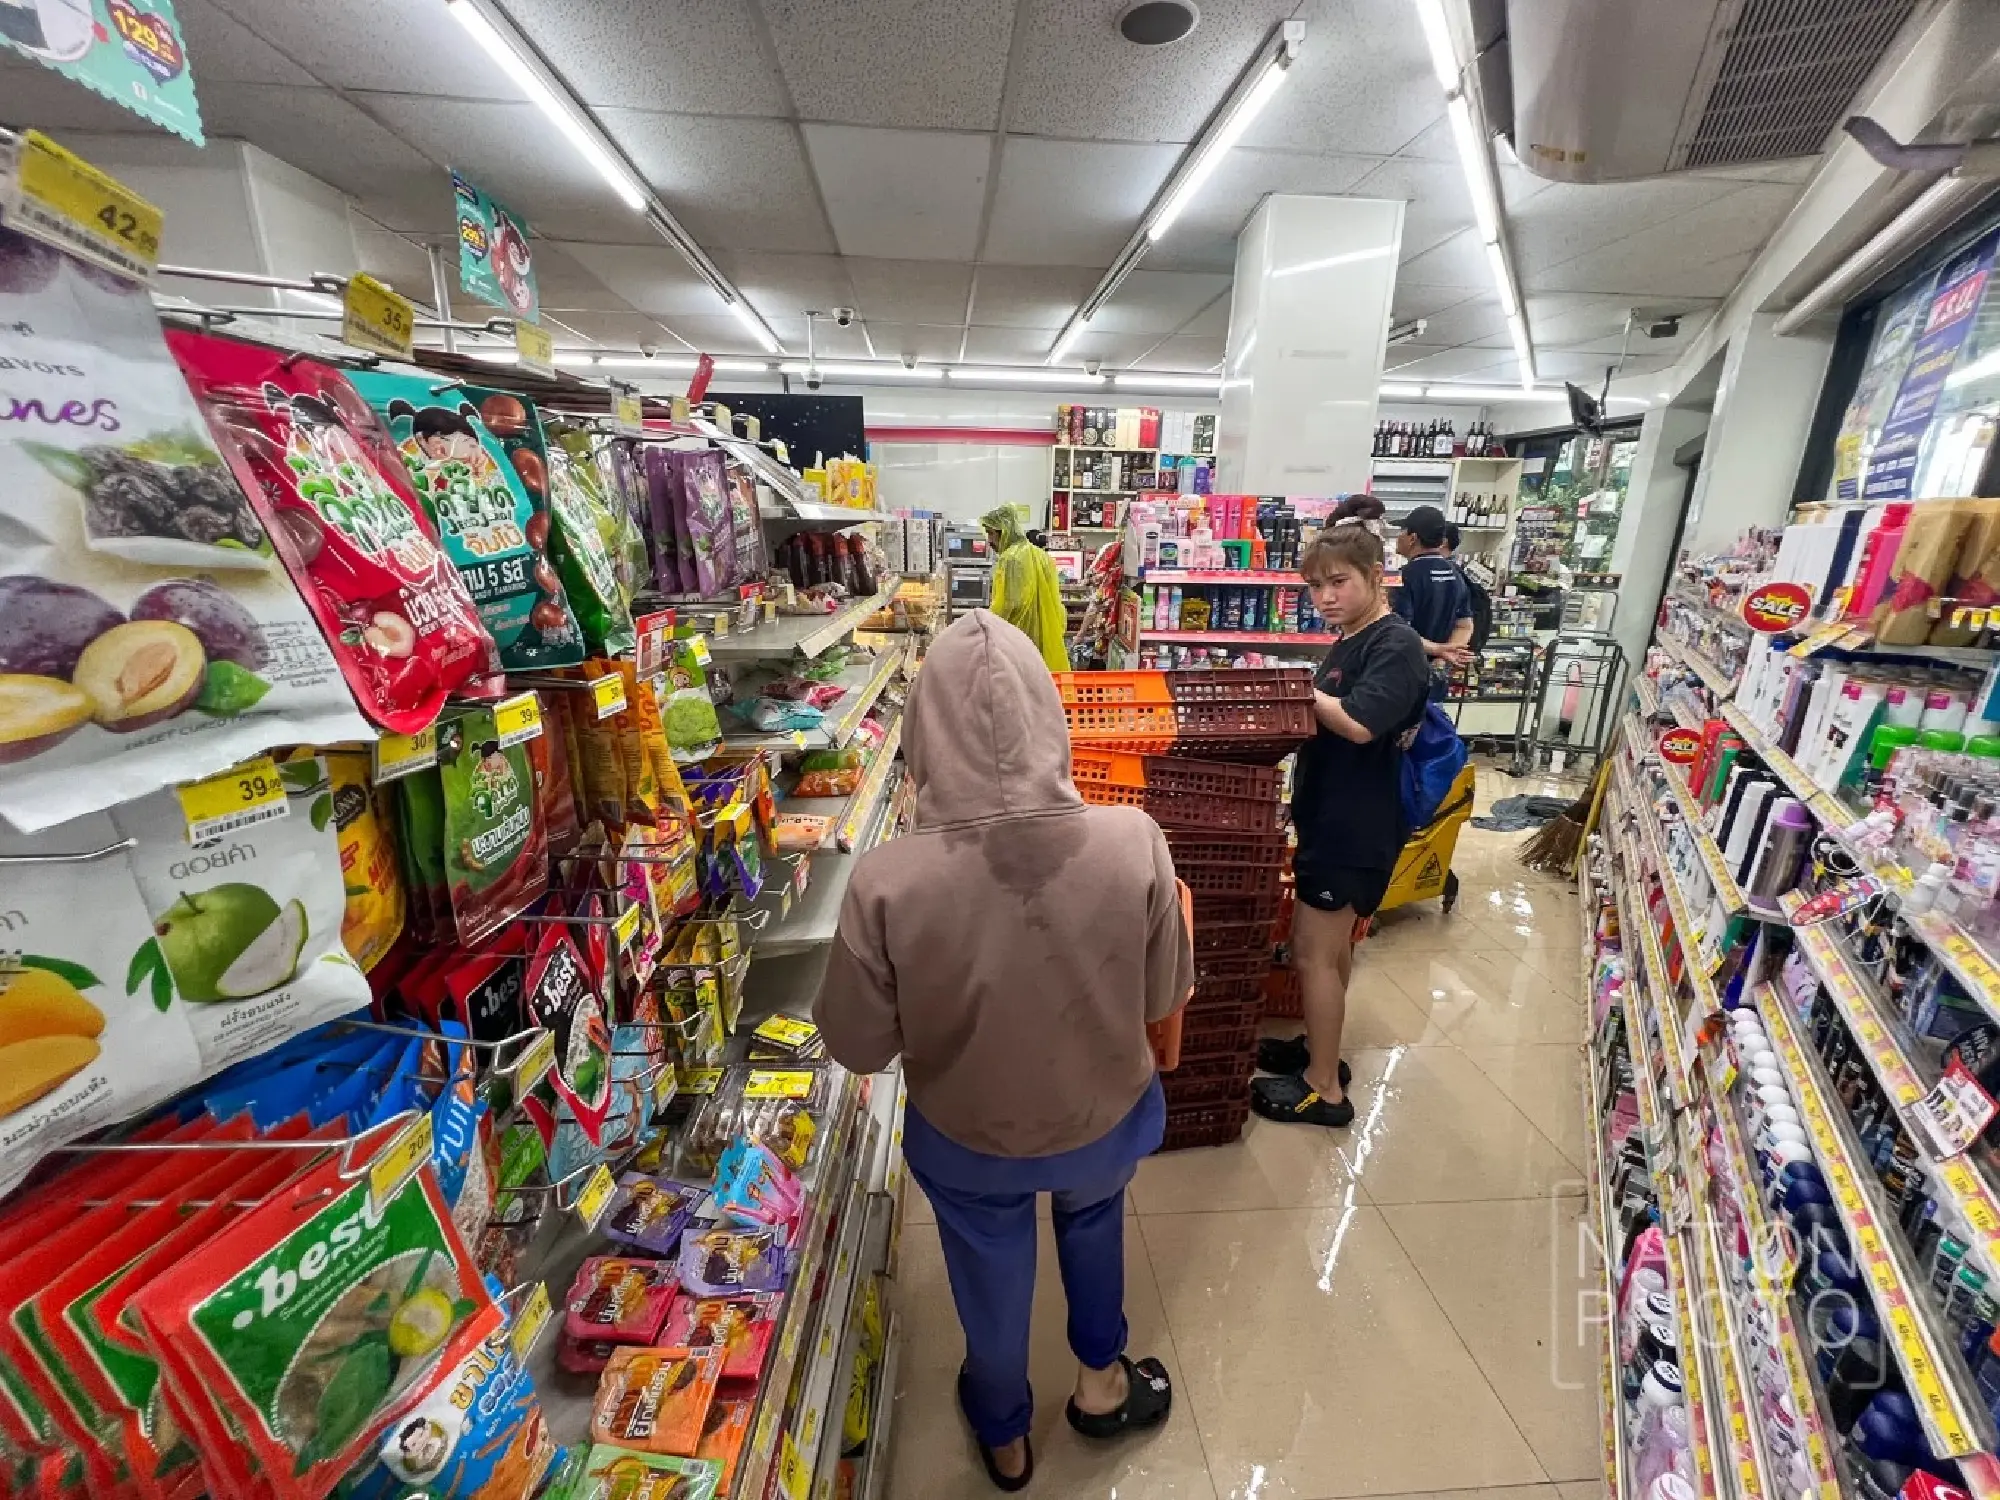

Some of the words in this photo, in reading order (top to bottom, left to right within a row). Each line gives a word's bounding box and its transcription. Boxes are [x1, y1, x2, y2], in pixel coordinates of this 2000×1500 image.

[0, 397, 121, 432] nes
[488, 563, 499, 589] 5
[1749, 597, 1805, 618] SALE
